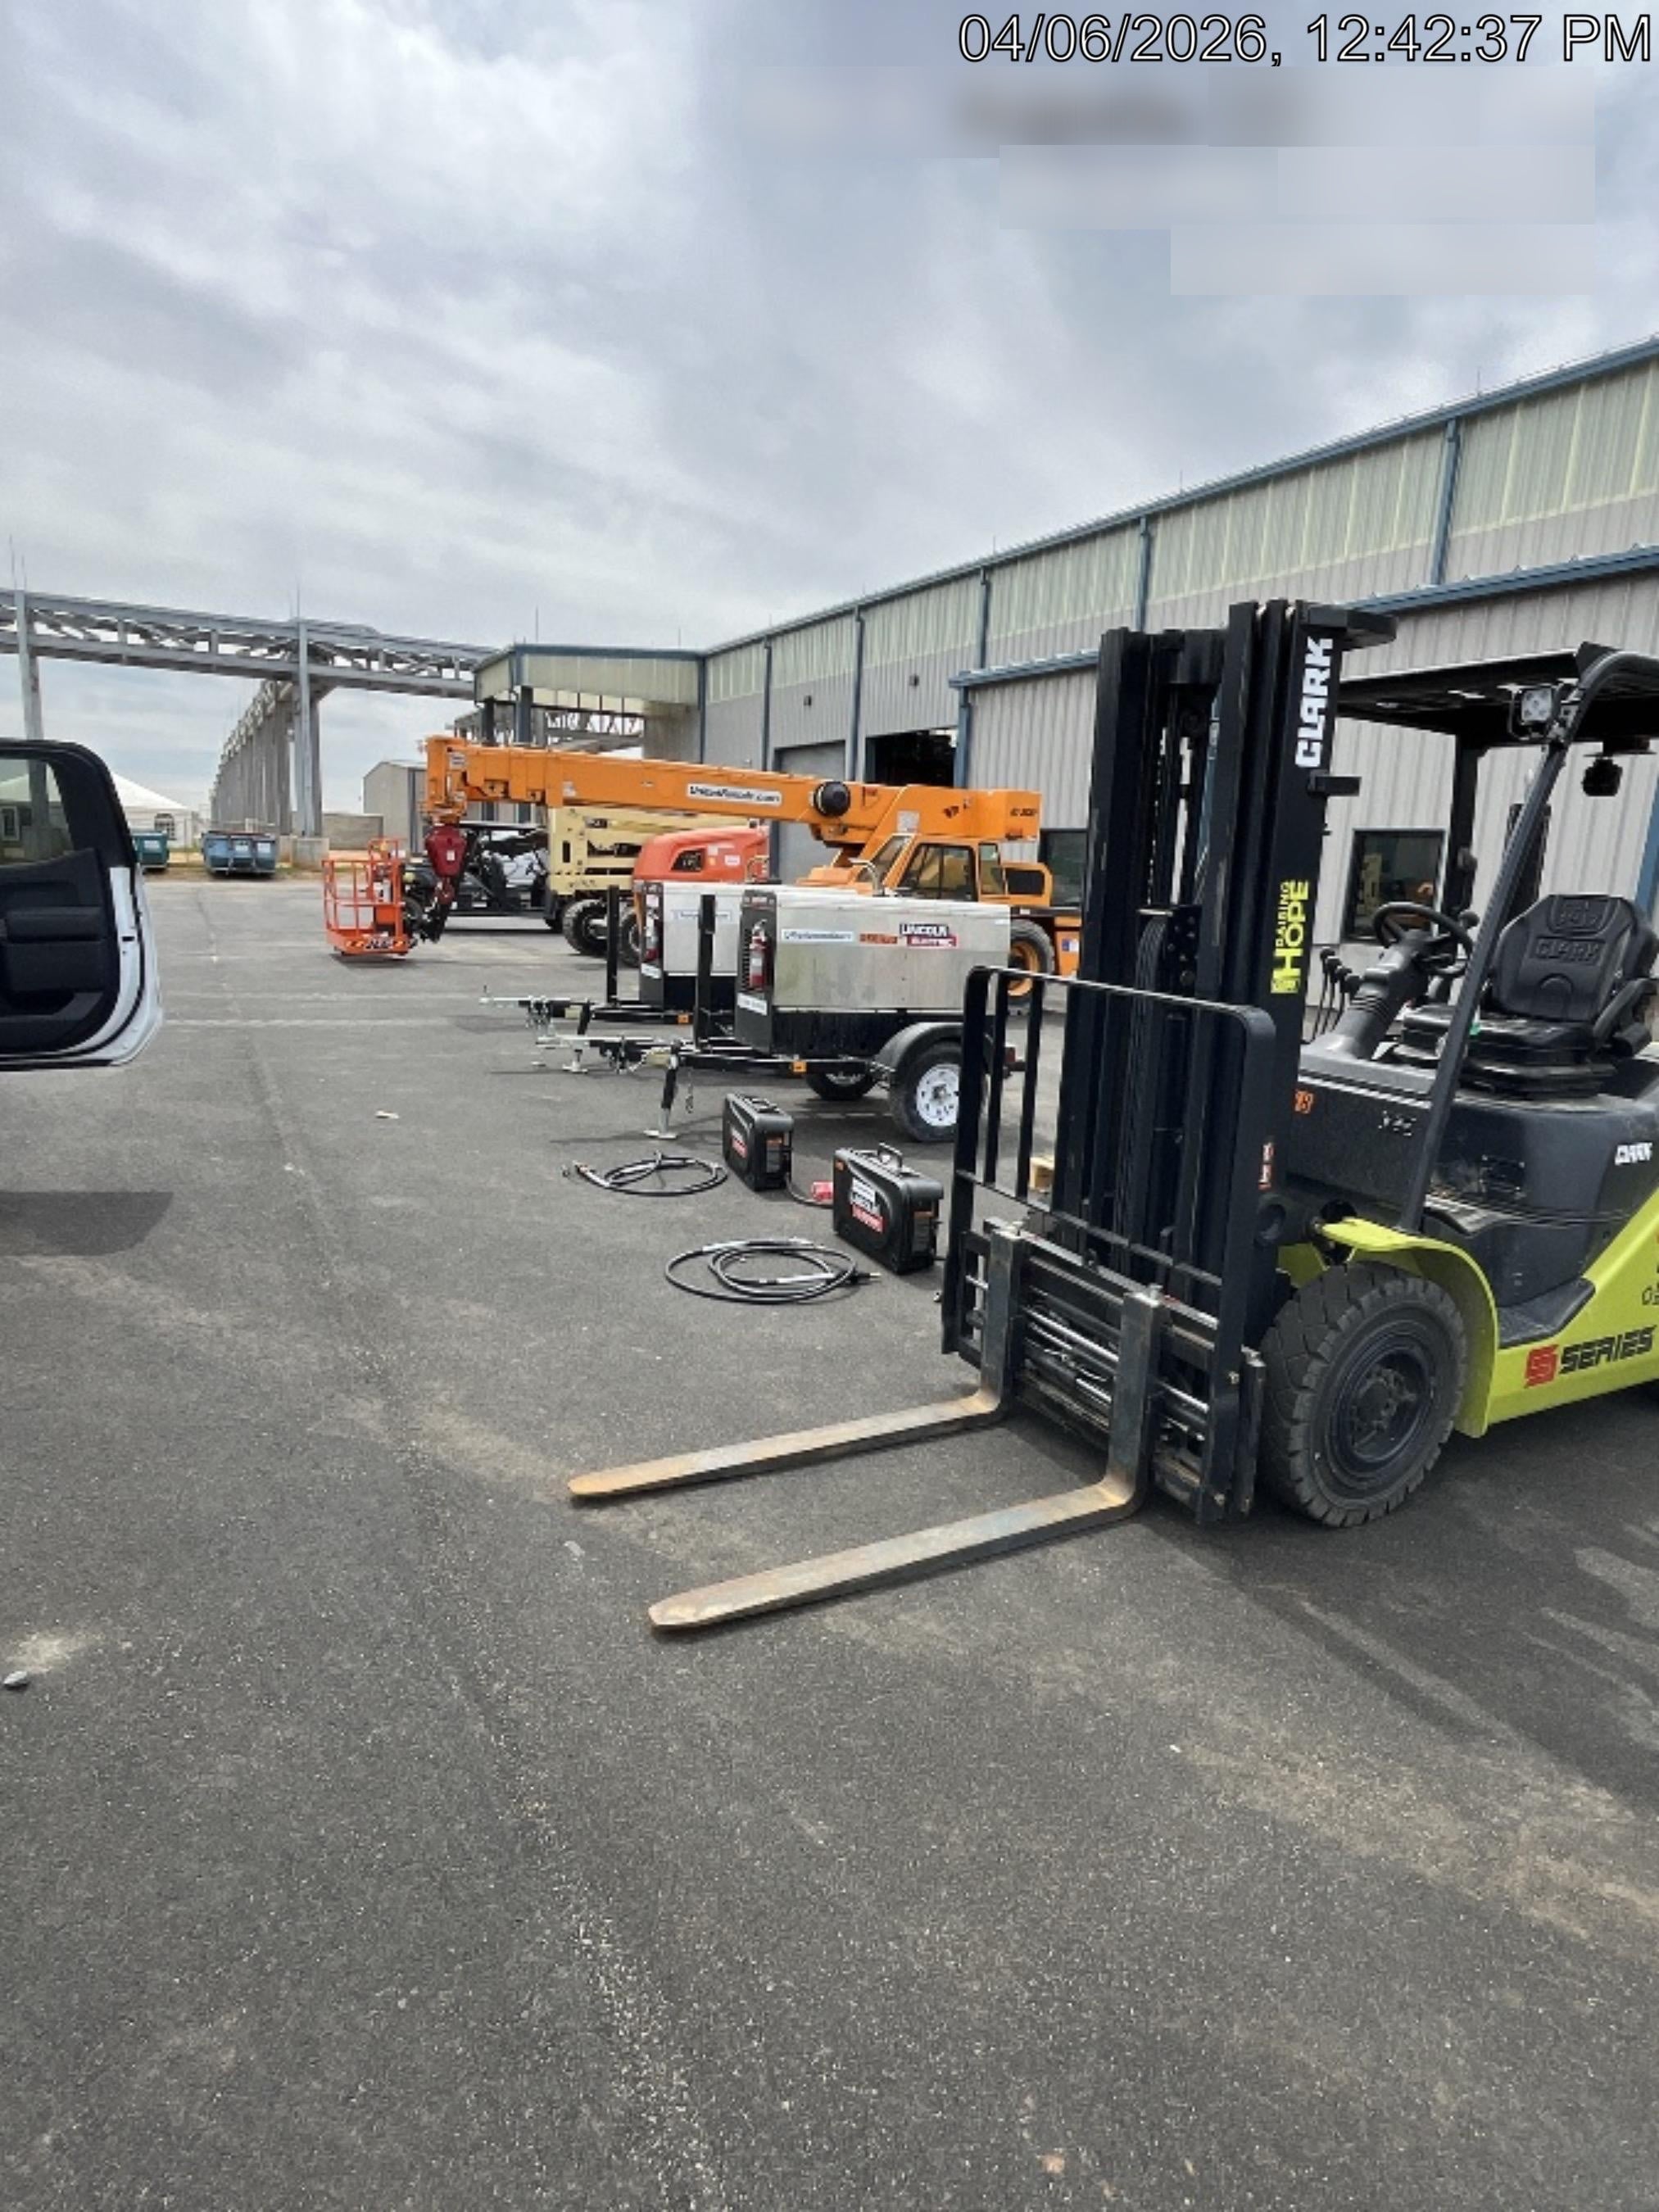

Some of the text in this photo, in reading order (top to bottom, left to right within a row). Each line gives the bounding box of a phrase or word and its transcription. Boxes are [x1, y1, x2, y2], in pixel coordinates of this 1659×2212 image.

[1294, 636, 1334, 768] CLARK
[1272, 878, 1310, 980] HOPE
[1558, 1324, 1657, 1375] SERIES
